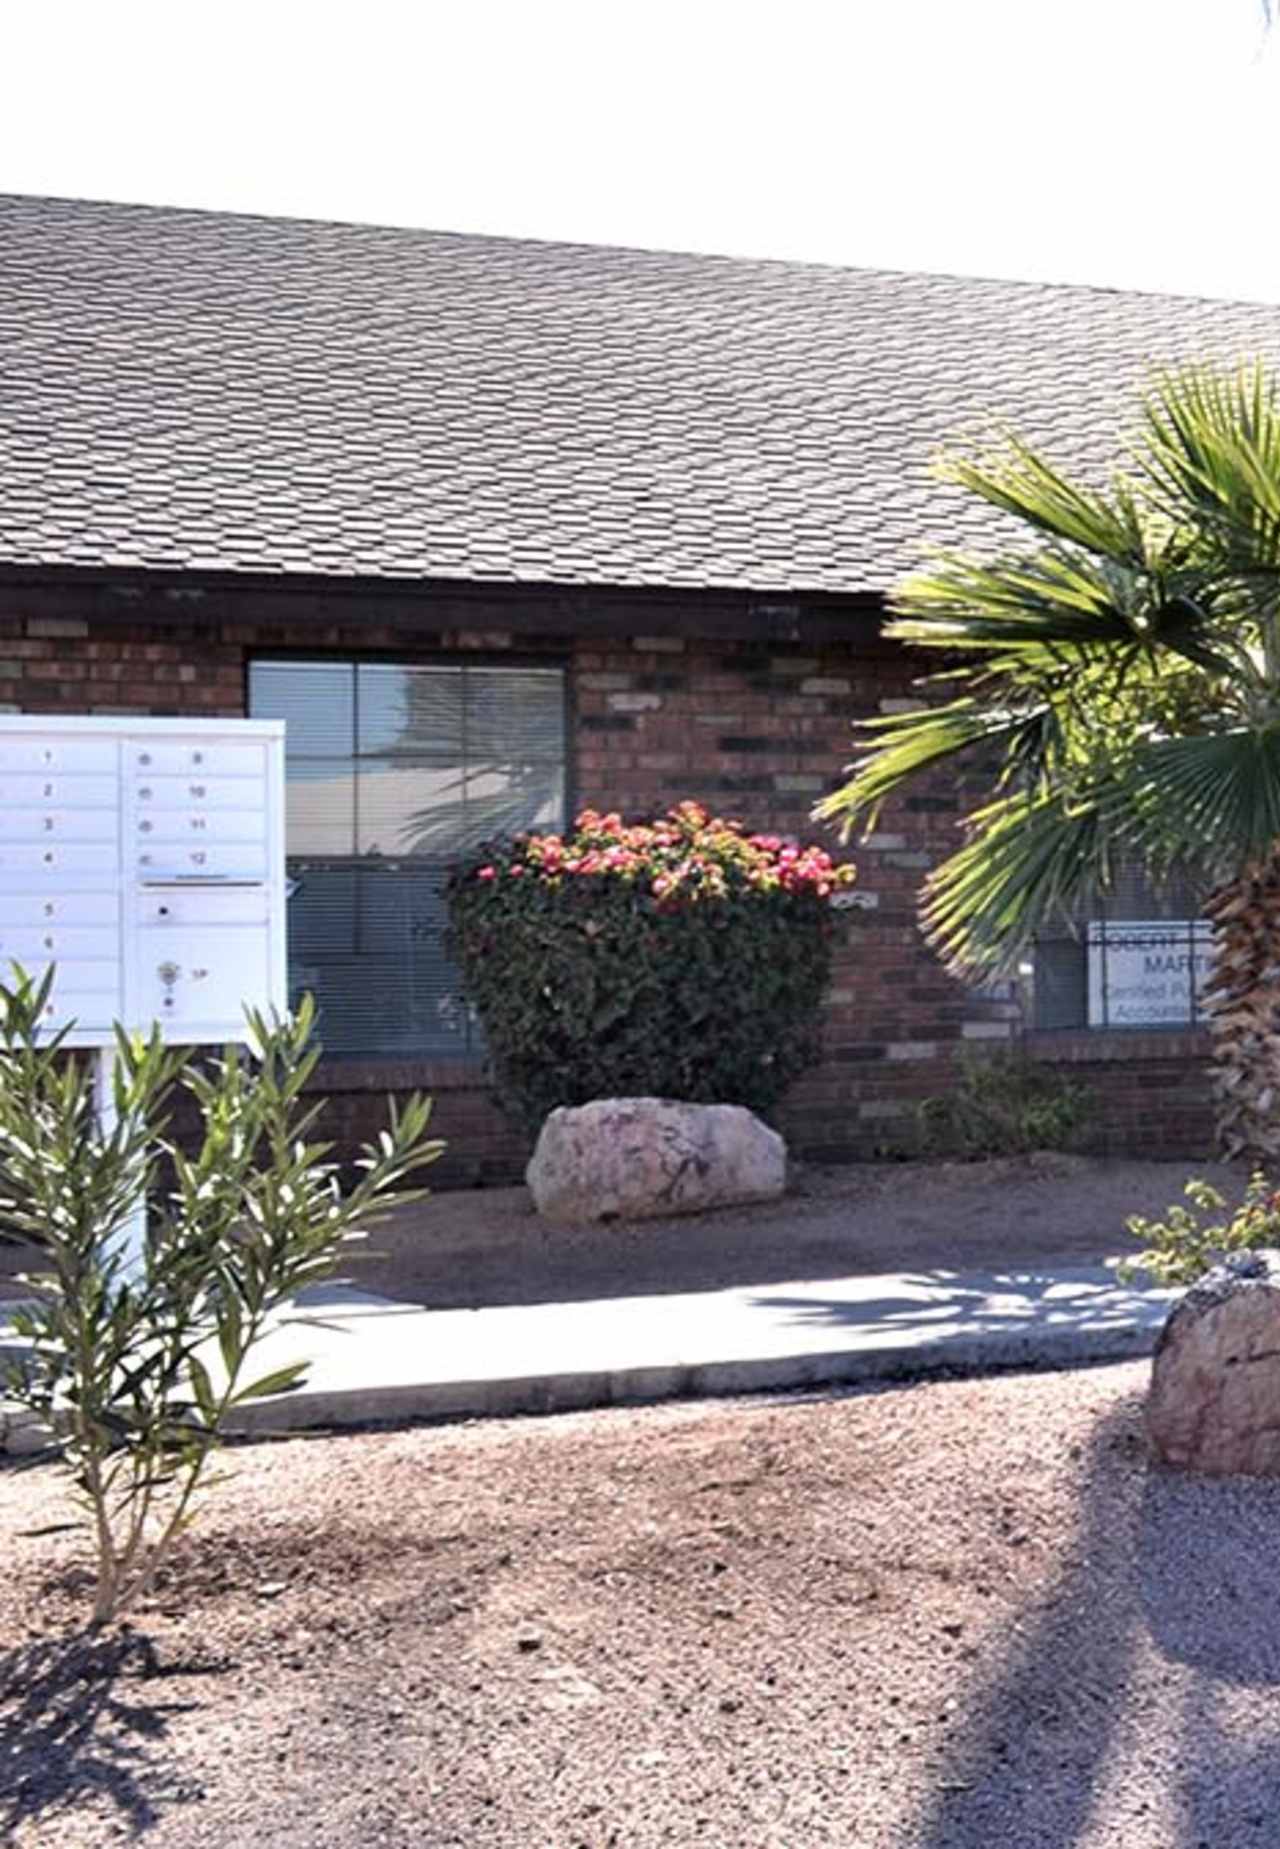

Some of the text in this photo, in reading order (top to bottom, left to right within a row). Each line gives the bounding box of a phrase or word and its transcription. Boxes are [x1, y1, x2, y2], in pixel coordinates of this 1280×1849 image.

[43, 782, 54, 797] 2
[44, 816, 54, 831] 3
[189, 850, 206, 866] 12
